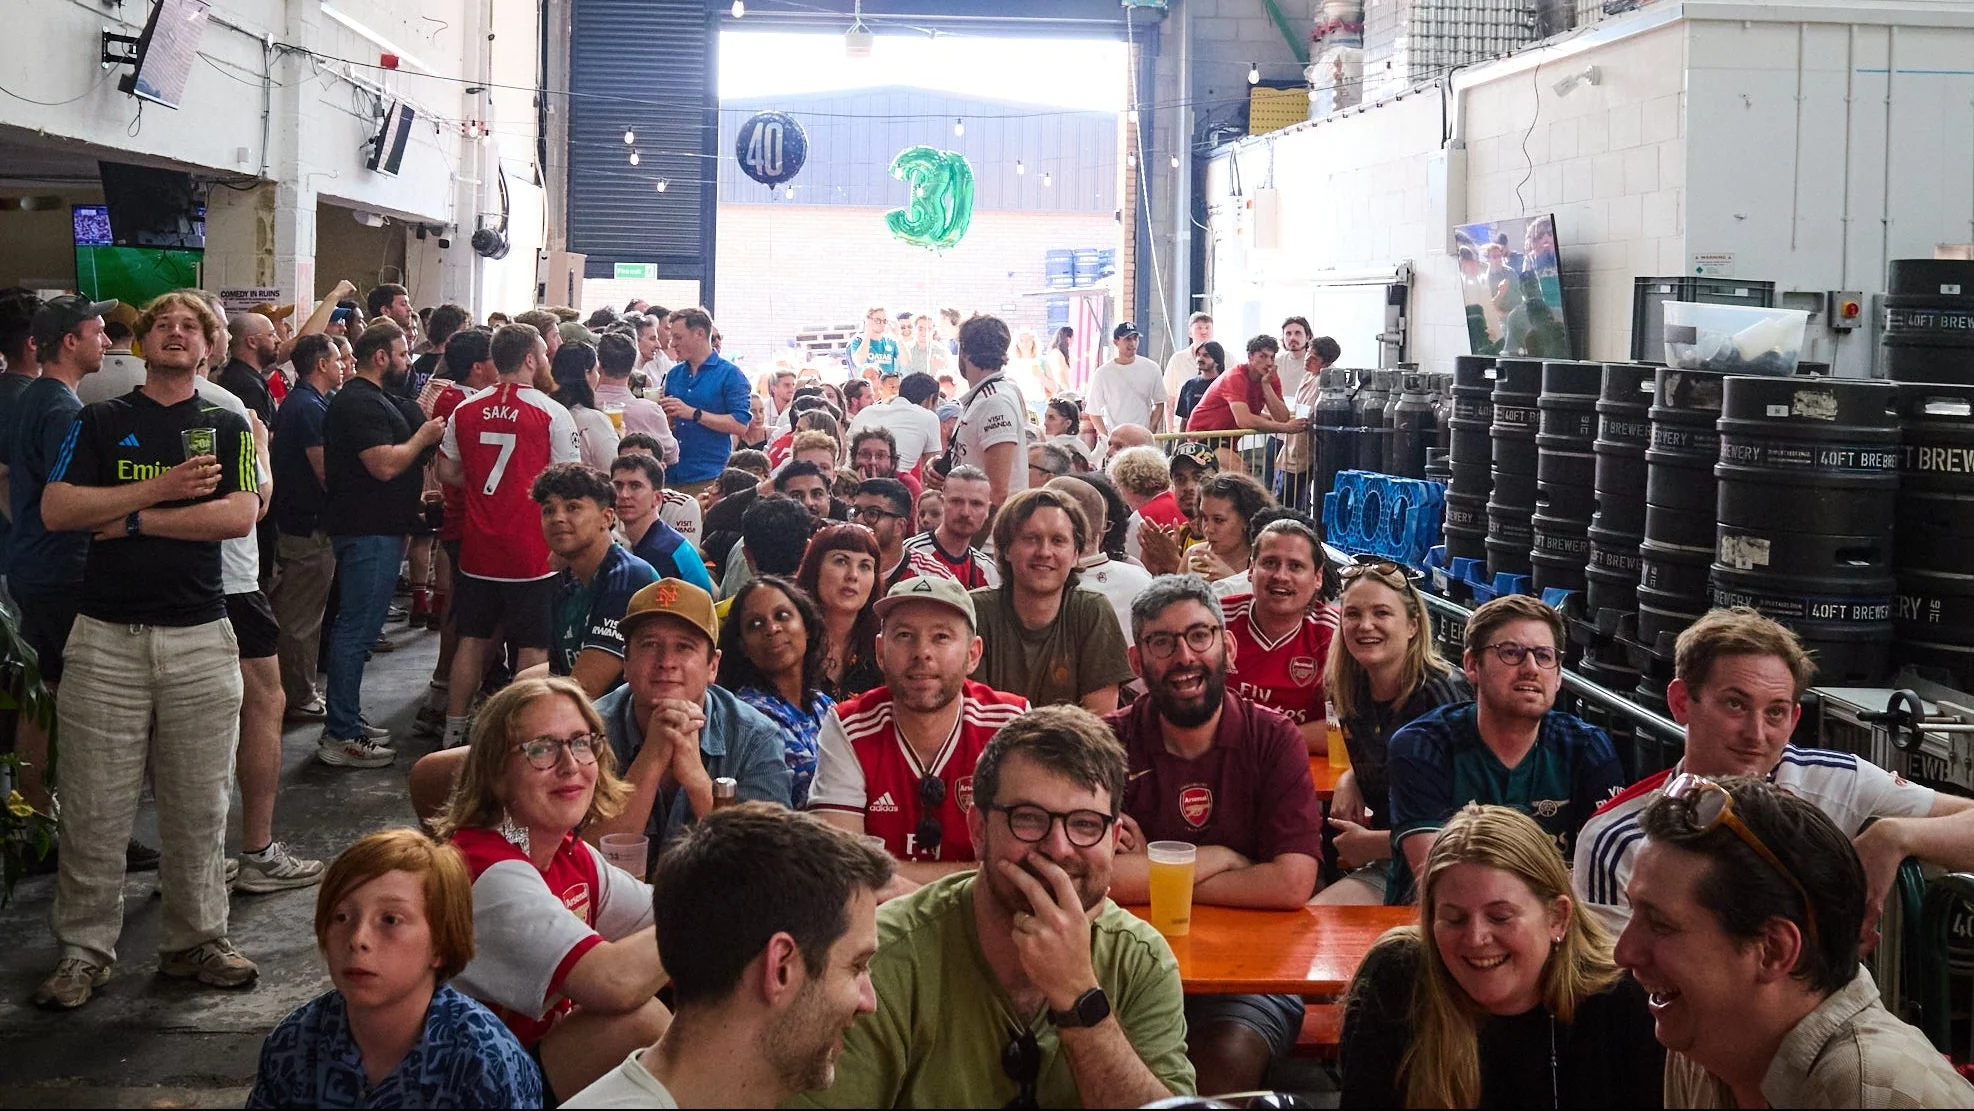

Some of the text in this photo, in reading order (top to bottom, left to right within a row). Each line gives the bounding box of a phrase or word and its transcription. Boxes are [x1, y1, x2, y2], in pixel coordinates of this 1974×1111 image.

[746, 121, 783, 176] 40
[220, 290, 248, 298] COMEDY
[1908, 314, 1934, 327] 40FT
[482, 405, 520, 423] SAKA
[987, 414, 1005, 423] VISIT
[983, 420, 1013, 433] RWANDA
[479, 431, 517, 496] 7
[1820, 451, 1855, 467] 40FT
[1929, 599, 1941, 610] 40
[1811, 603, 1846, 620] 40FT
[1929, 614, 1940, 623] FT
[869, 804, 899, 812] adidas
[565, 891, 588, 908] Arsenal
